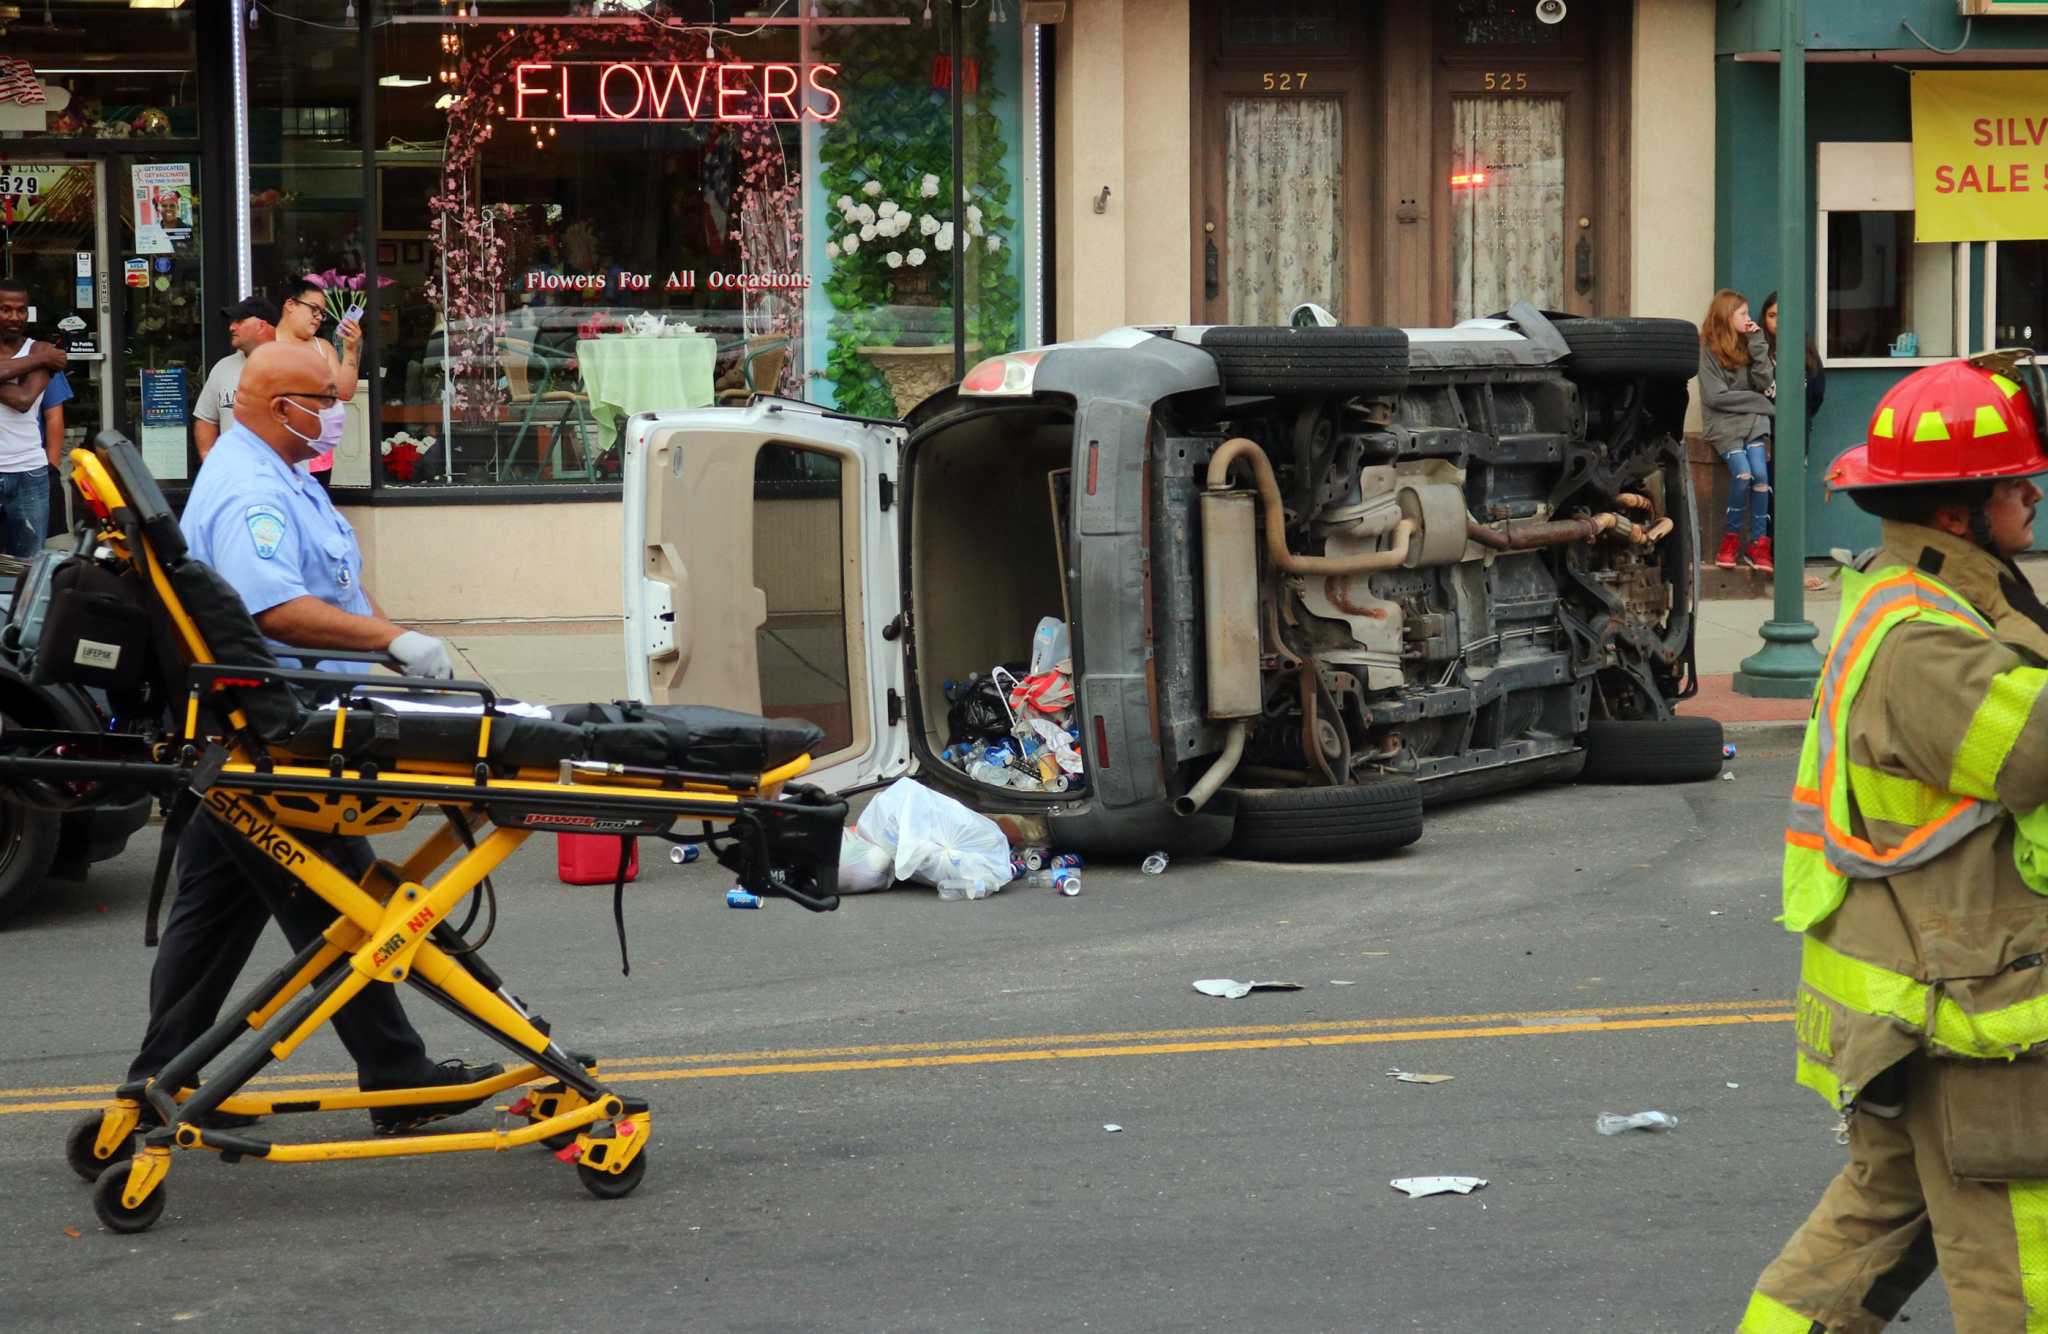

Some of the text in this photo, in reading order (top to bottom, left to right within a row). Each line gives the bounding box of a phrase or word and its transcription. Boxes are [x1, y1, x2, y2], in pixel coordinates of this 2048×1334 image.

[515, 63, 841, 120] FLOWERS
[1263, 72, 1308, 90] 527
[1485, 72, 1528, 90] 525
[1973, 117, 2048, 147] SILV
[0, 177, 37, 193] 529
[1935, 164, 2030, 193] SALE
[527, 270, 813, 291] Flowers For All Occasions
[202, 790, 306, 867] stryker
[769, 869, 786, 882] MR
[406, 905, 436, 934] NH
